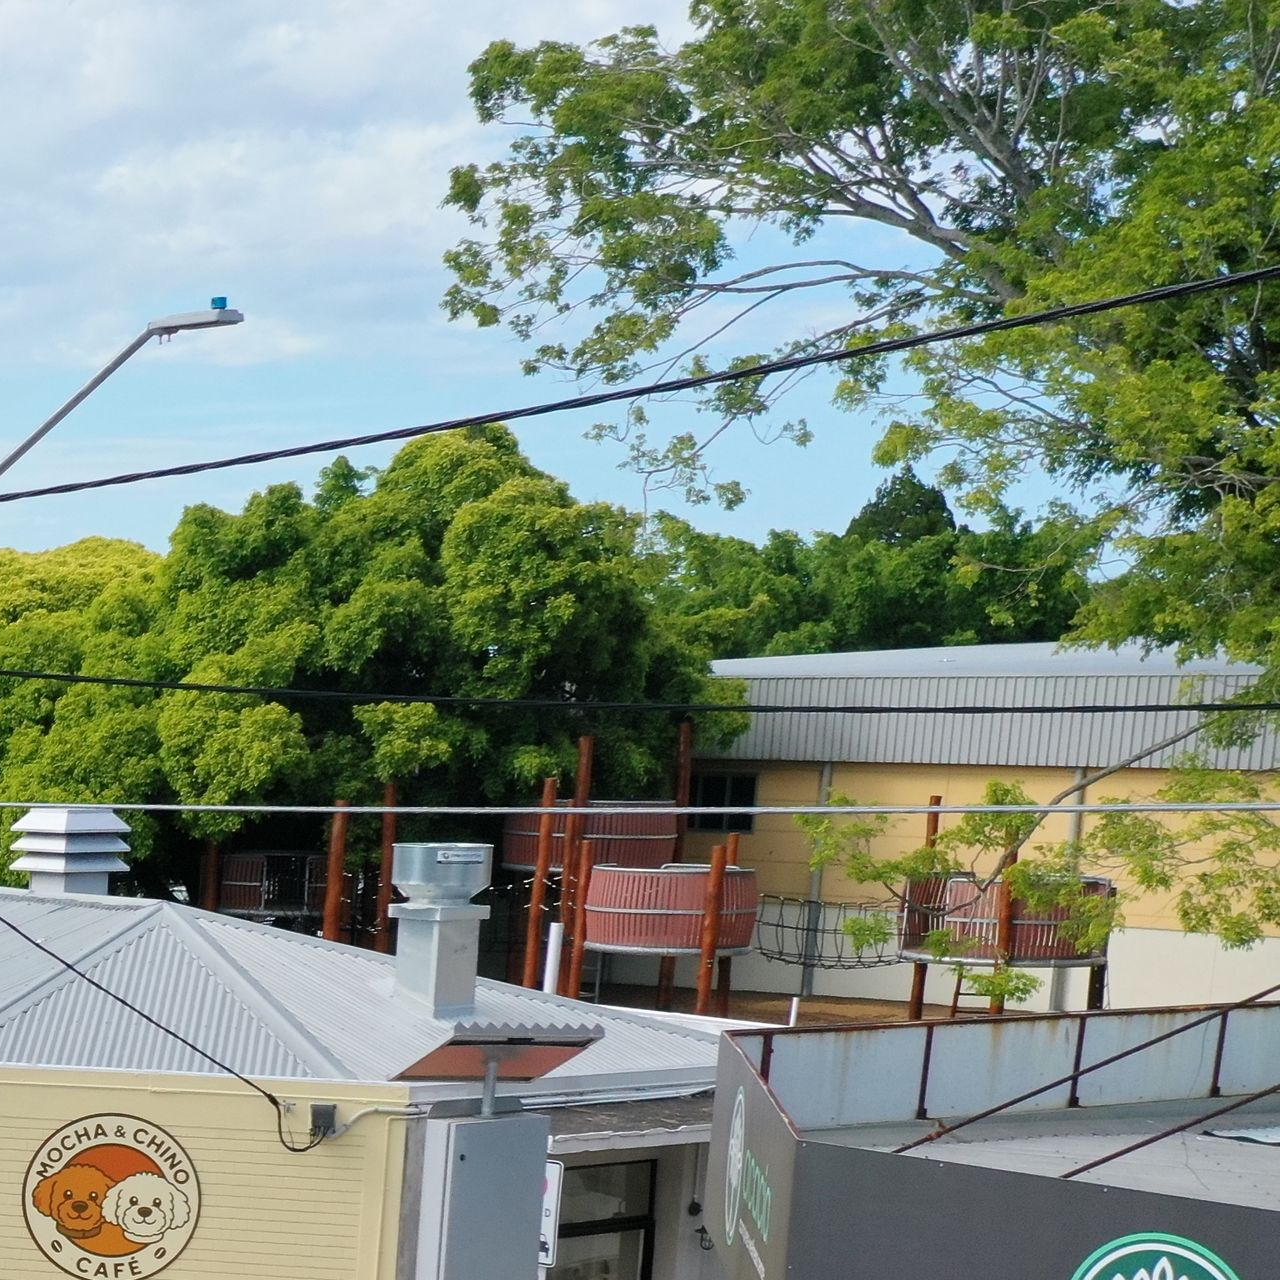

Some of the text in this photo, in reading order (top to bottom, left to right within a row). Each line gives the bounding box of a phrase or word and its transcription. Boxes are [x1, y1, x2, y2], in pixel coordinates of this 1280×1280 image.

[37, 1123, 190, 1186] MOCHA & CHINO
[76, 1256, 142, 1279] CAFÉ
